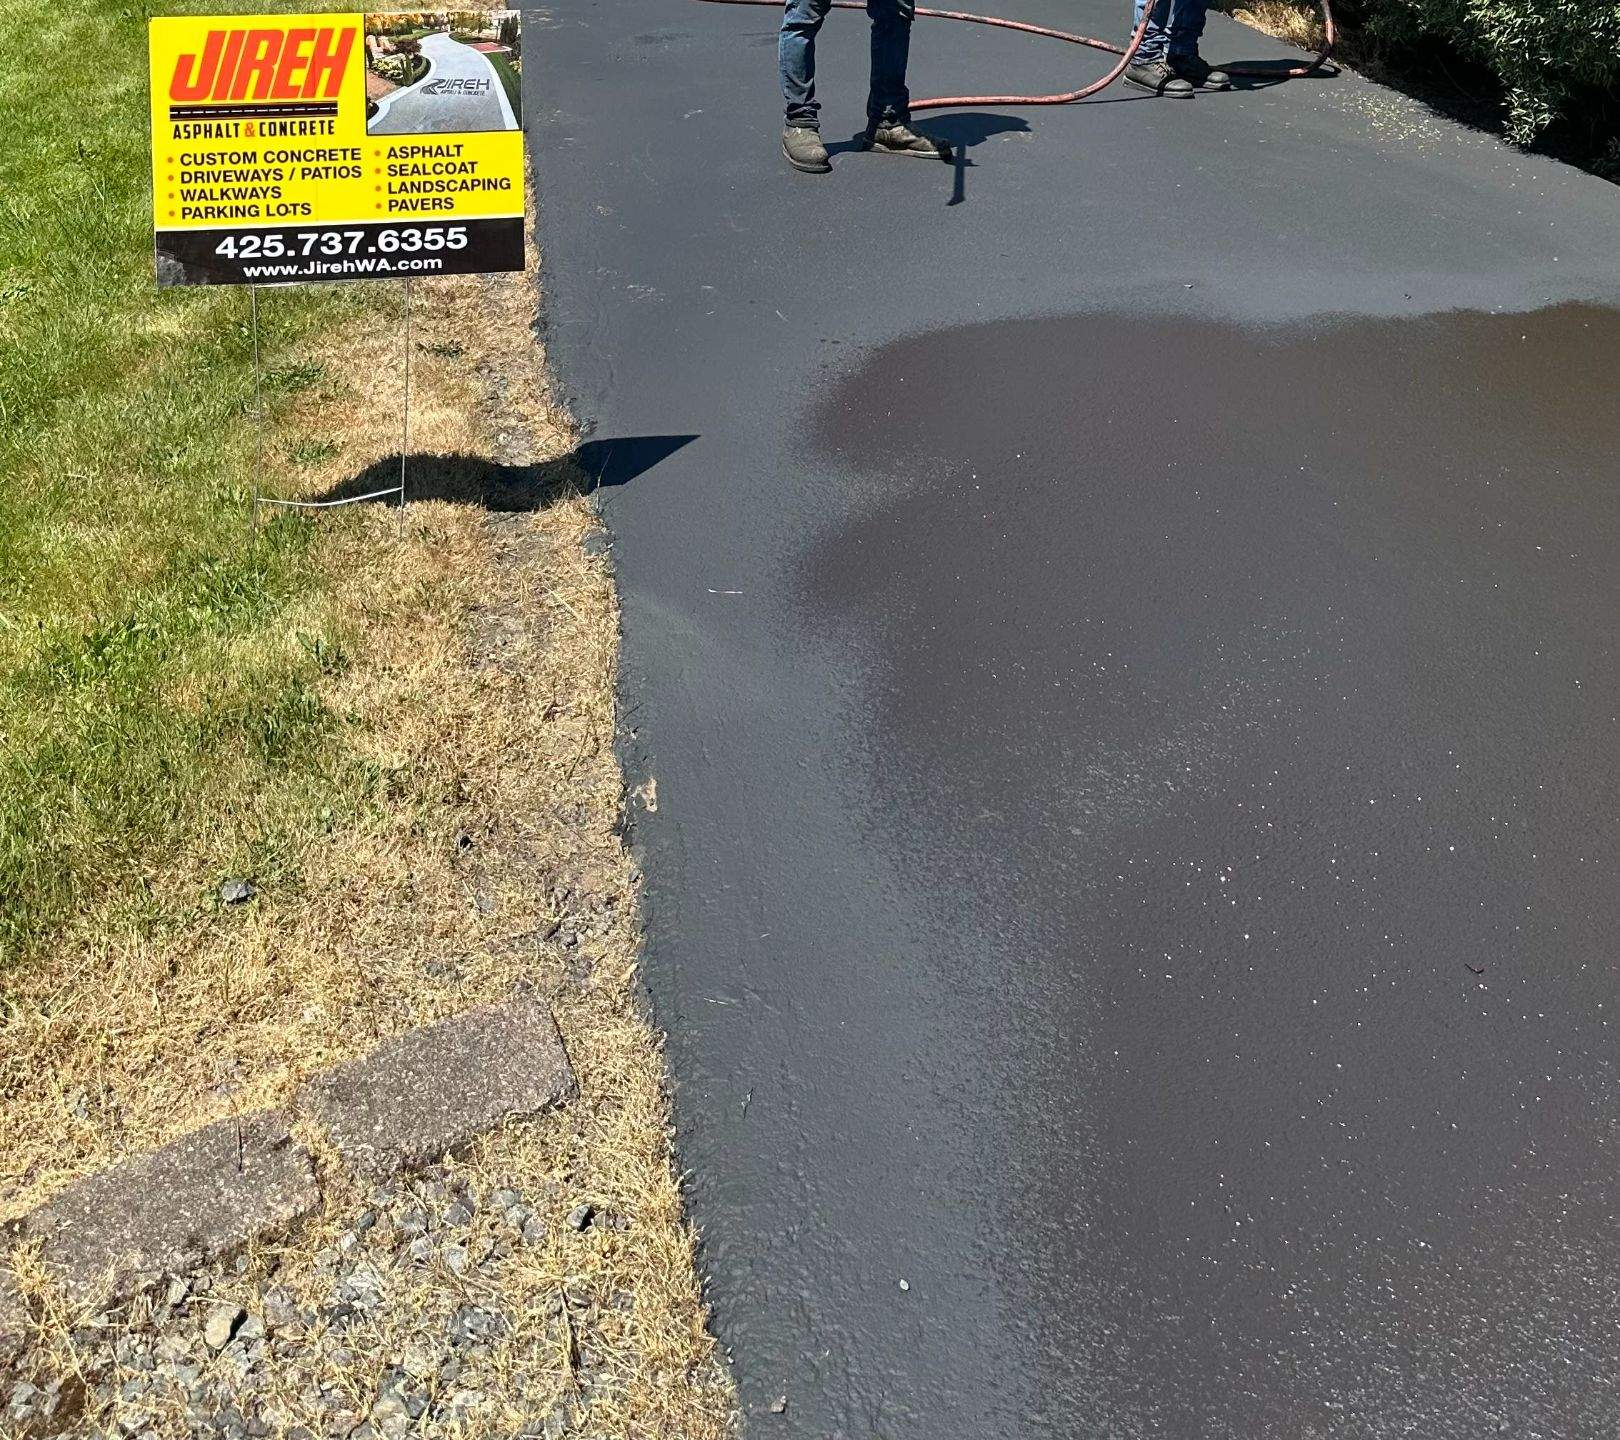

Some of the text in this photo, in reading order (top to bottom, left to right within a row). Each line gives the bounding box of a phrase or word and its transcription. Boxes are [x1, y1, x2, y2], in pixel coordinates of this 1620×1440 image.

[169, 28, 356, 101] JIREH
[437, 78, 490, 90] JIREH
[173, 120, 335, 139] ASPHALT & CONCRETE
[180, 148, 362, 166] CUSTOM CONCRETE
[387, 144, 463, 159] ASPHALT
[180, 165, 362, 184] DRIVEWAYS / PATIOS
[387, 161, 478, 177] SEALCOAT
[180, 186, 282, 202] WALKWAYS
[388, 177, 511, 194] LANDSCAPING
[181, 203, 312, 219] PARKING LOTS
[388, 197, 454, 212] PAVERS
[215, 227, 468, 259] 425.737.6355
[243, 258, 442, 277] www.JirehWA.com
